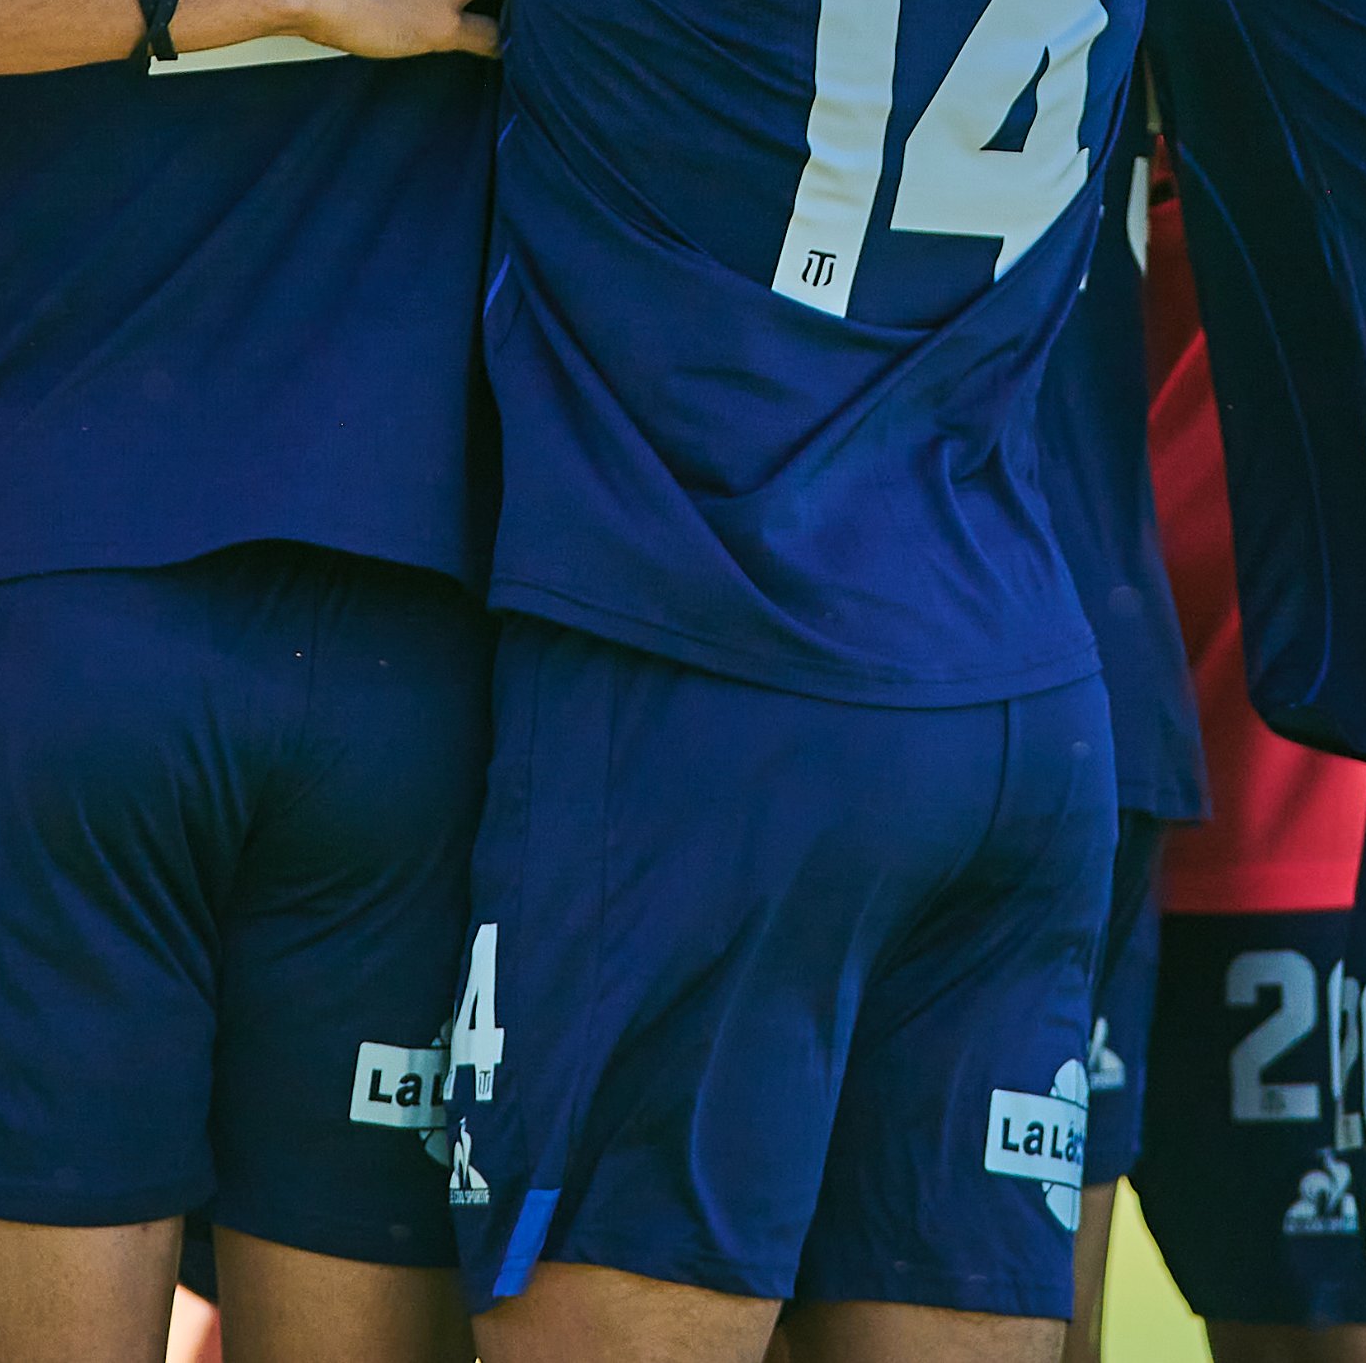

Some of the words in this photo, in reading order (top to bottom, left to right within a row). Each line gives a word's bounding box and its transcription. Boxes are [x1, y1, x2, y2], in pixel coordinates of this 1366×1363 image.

[443, 922, 505, 1101] 4
[368, 1069, 423, 1108] La
[1002, 1117, 1045, 1156] La
